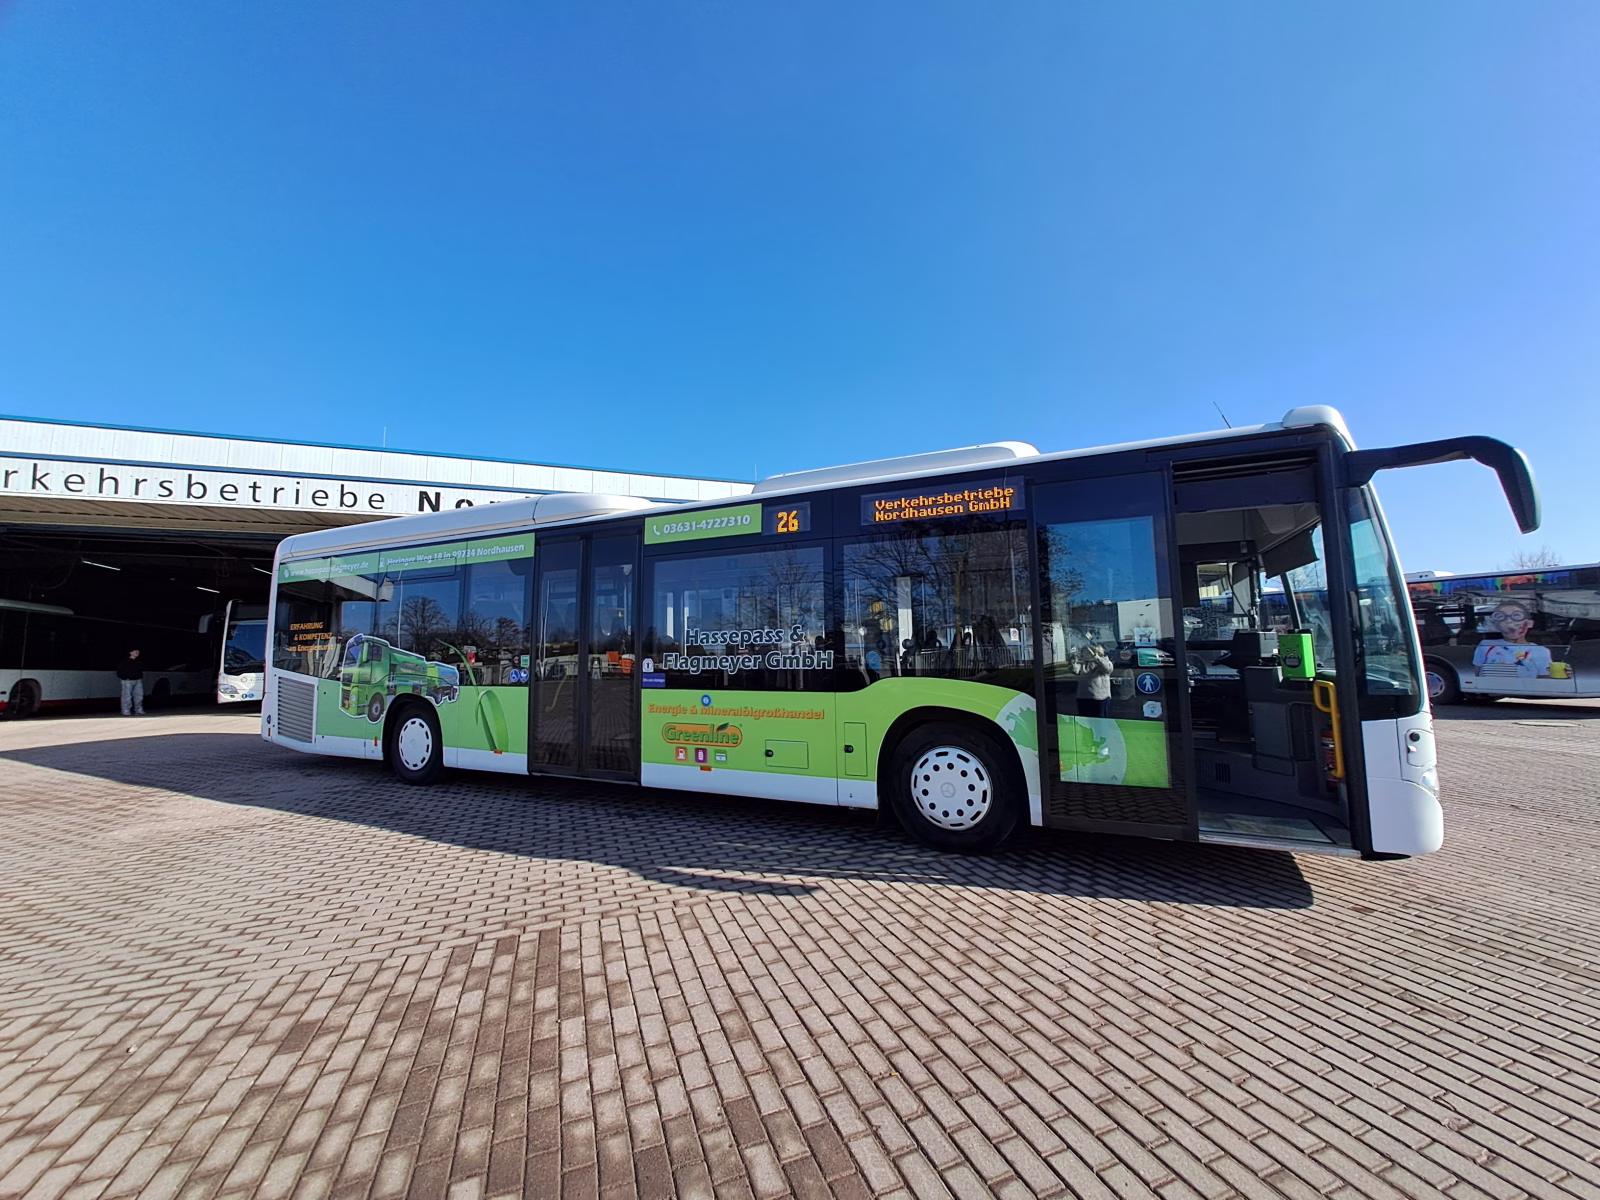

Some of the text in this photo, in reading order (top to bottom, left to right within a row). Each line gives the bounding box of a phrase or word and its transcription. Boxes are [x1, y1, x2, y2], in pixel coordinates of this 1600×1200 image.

[4, 463, 385, 510] rkehrsbetriebe
[875, 486, 1014, 510] Verkehrsbetriebe
[875, 497, 1011, 522] Nordhausen GmbH
[663, 515, 750, 533] 03631-4727310
[777, 510, 799, 533] 26
[416, 554, 432, 564] Weg
[452, 549, 476, 559] 99734
[477, 544, 525, 556] Nordhausen
[290, 622, 323, 631] ERFAHRUNG
[686, 625, 805, 649] Hassepass &
[662, 650, 834, 674] Flagmeyer GmbH
[647, 703, 825, 720] Energie & Mineralölgroßhandel
[664, 723, 740, 745] Greenline
